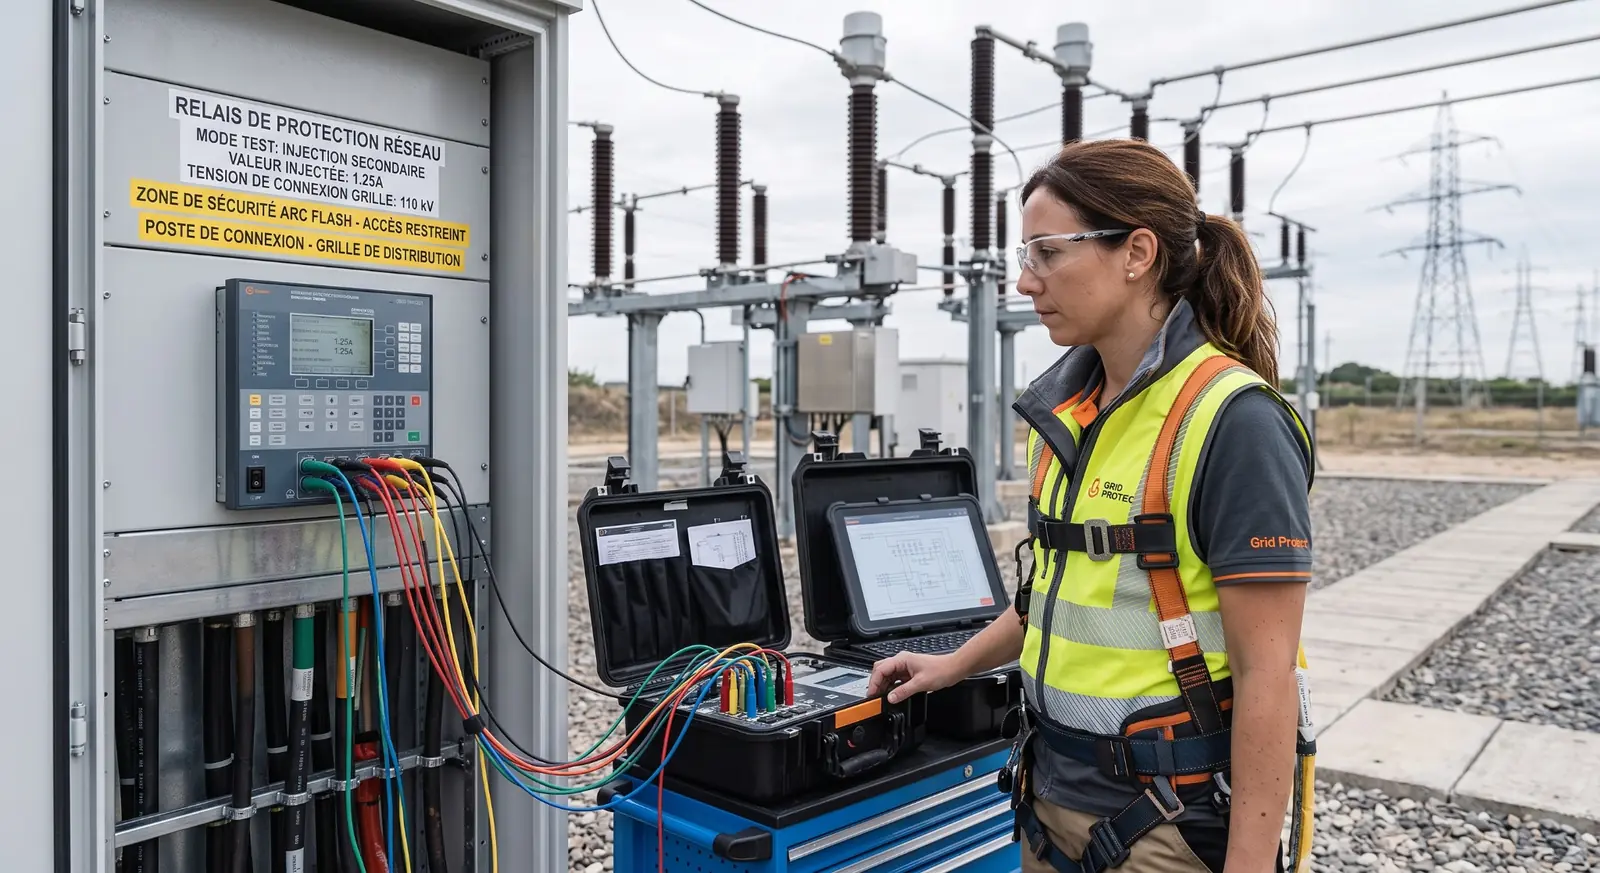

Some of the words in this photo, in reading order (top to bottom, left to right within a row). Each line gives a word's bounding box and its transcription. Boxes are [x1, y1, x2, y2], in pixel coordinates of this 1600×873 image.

[175, 96, 242, 125] RELAIS
[248, 110, 271, 130] DE
[277, 115, 379, 150] PROTECTION
[384, 135, 441, 161] RÉSEAU
[196, 127, 238, 147] MODE
[242, 135, 278, 154] TEST:
[282, 142, 348, 165] INJECTION
[351, 154, 425, 179] SECONDAIRE
[228, 151, 281, 172] VALEUR
[285, 161, 349, 183] INJECTÉE:
[353, 172, 384, 189] 1.25A
[187, 163, 248, 185] TENSION
[252, 174, 270, 189] DE
[273, 177, 348, 200] CONNEXION
[351, 189, 397, 207] GRILLE:
[400, 196, 418, 210] 110
[421, 199, 434, 213] kV
[136, 186, 179, 206] ZONE
[183, 192, 203, 209] DE
[207, 193, 276, 218] SÉCURITÉ
[280, 206, 307, 222] ARC
[311, 210, 352, 227] FLASH
[363, 216, 402, 234] ACCÈS
[405, 222, 466, 242] RESTREINT
[145, 219, 195, 239] POSTE
[200, 225, 219, 241] DE
[223, 228, 304, 250] CONNEXION
[316, 238, 361, 256] GRILLE
[364, 244, 380, 258] DE
[383, 246, 460, 267] DISTRIBUTION
[334, 338, 353, 346] 1.25A
[334, 347, 353, 355] 1.25A
[1103, 481, 1123, 491] GRID
[1250, 536, 1276, 548] Grid
